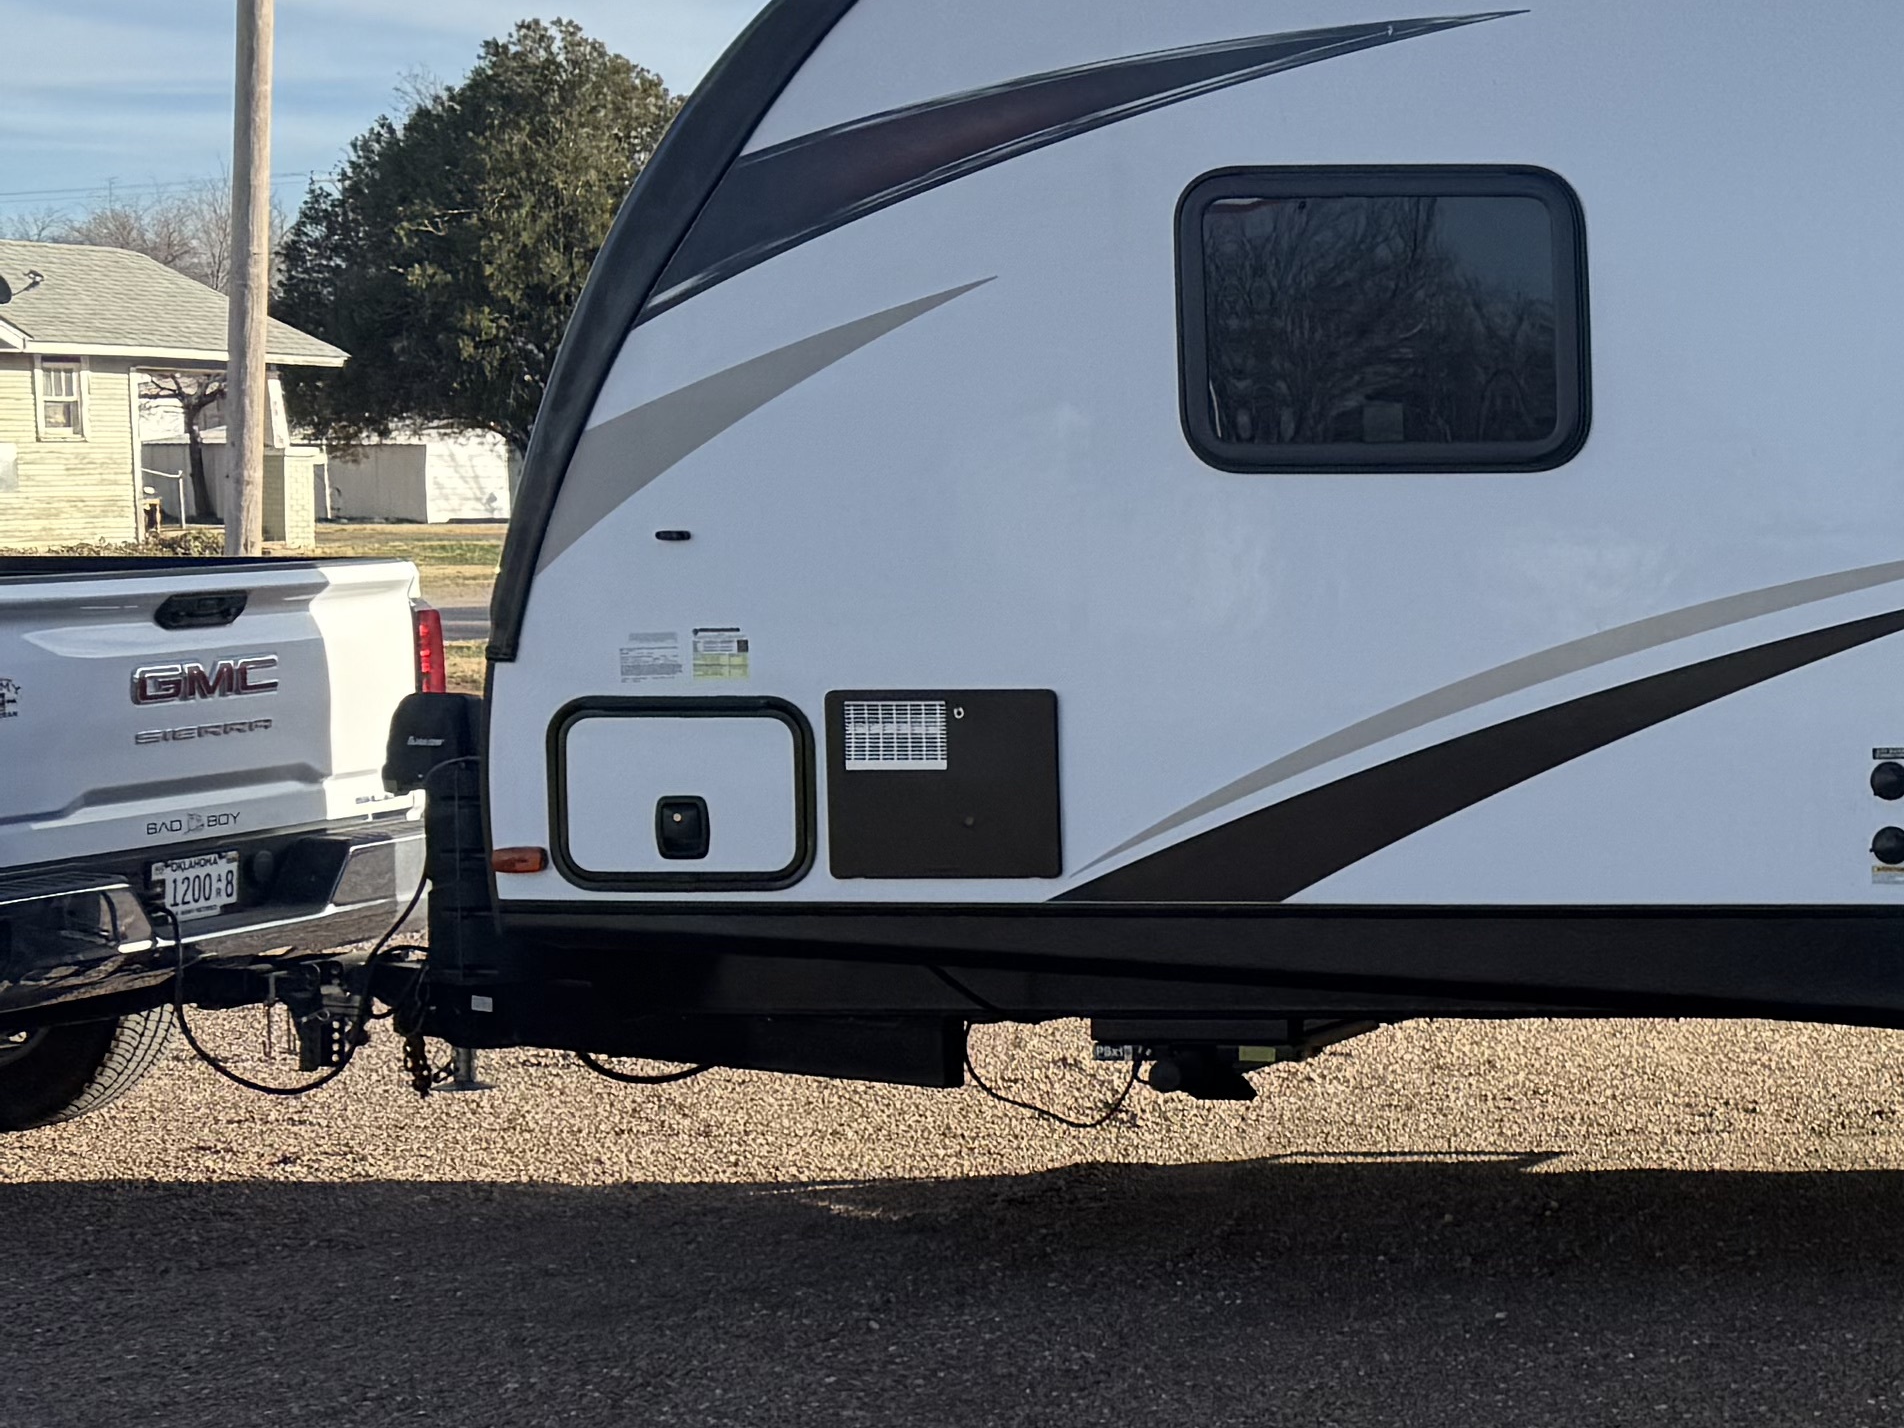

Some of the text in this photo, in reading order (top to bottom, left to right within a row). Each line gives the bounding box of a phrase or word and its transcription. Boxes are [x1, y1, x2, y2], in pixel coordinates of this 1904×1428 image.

[131, 654, 279, 705] GMC
[135, 719, 272, 745] SIERRA
[146, 812, 240, 835] BAD BOY
[170, 856, 219, 872] OKLAHOMA
[170, 873, 213, 908] 1200
